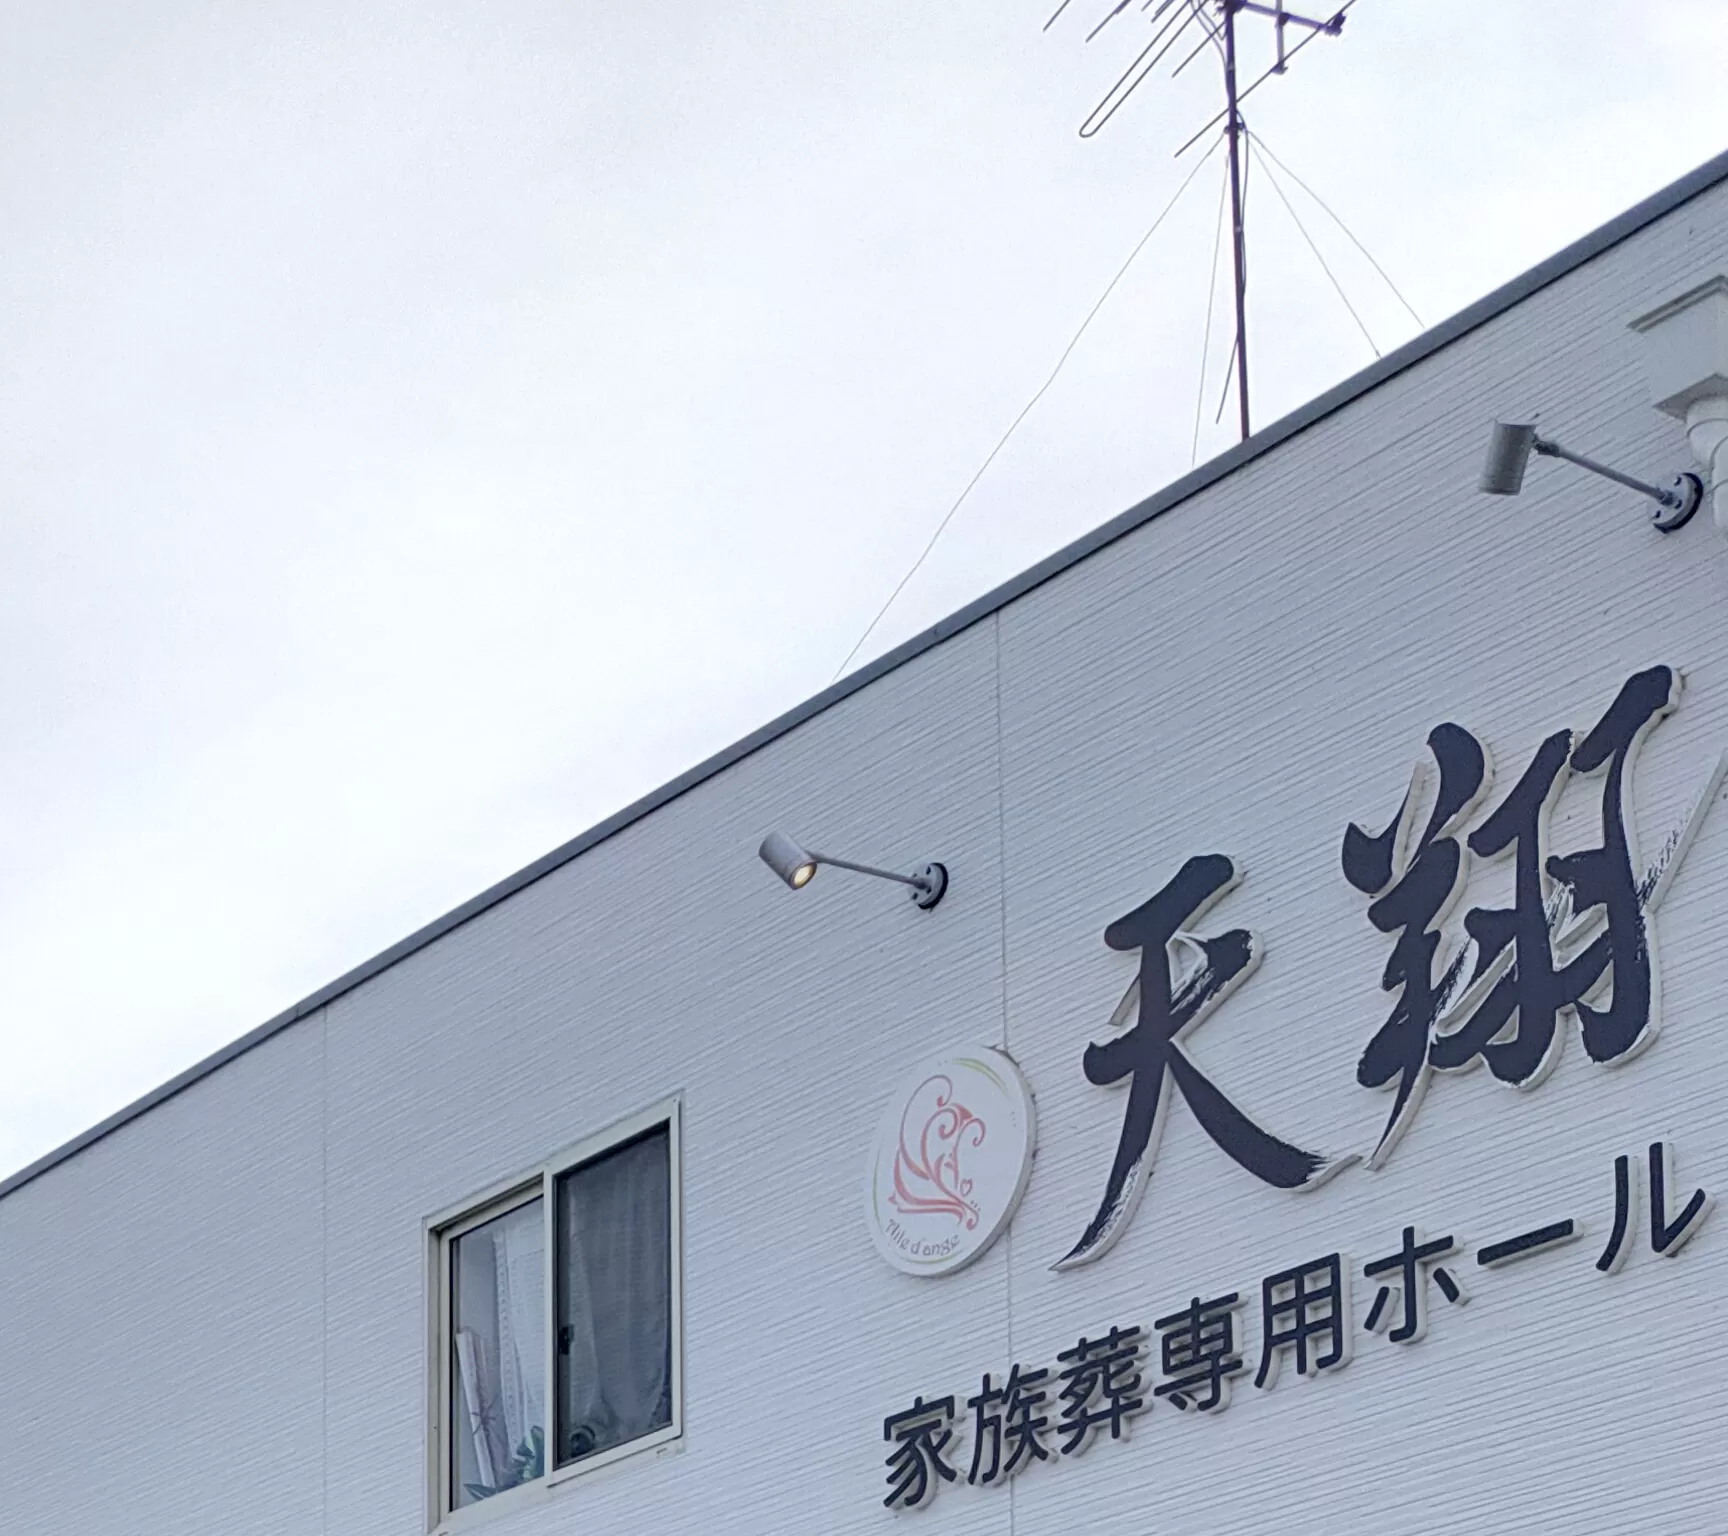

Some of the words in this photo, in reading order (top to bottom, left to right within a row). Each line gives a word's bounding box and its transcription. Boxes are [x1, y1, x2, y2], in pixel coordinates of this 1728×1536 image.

[1048, 664, 1696, 1271] 天翔
[883, 1140, 1707, 1509] 家族葬専用ホール
